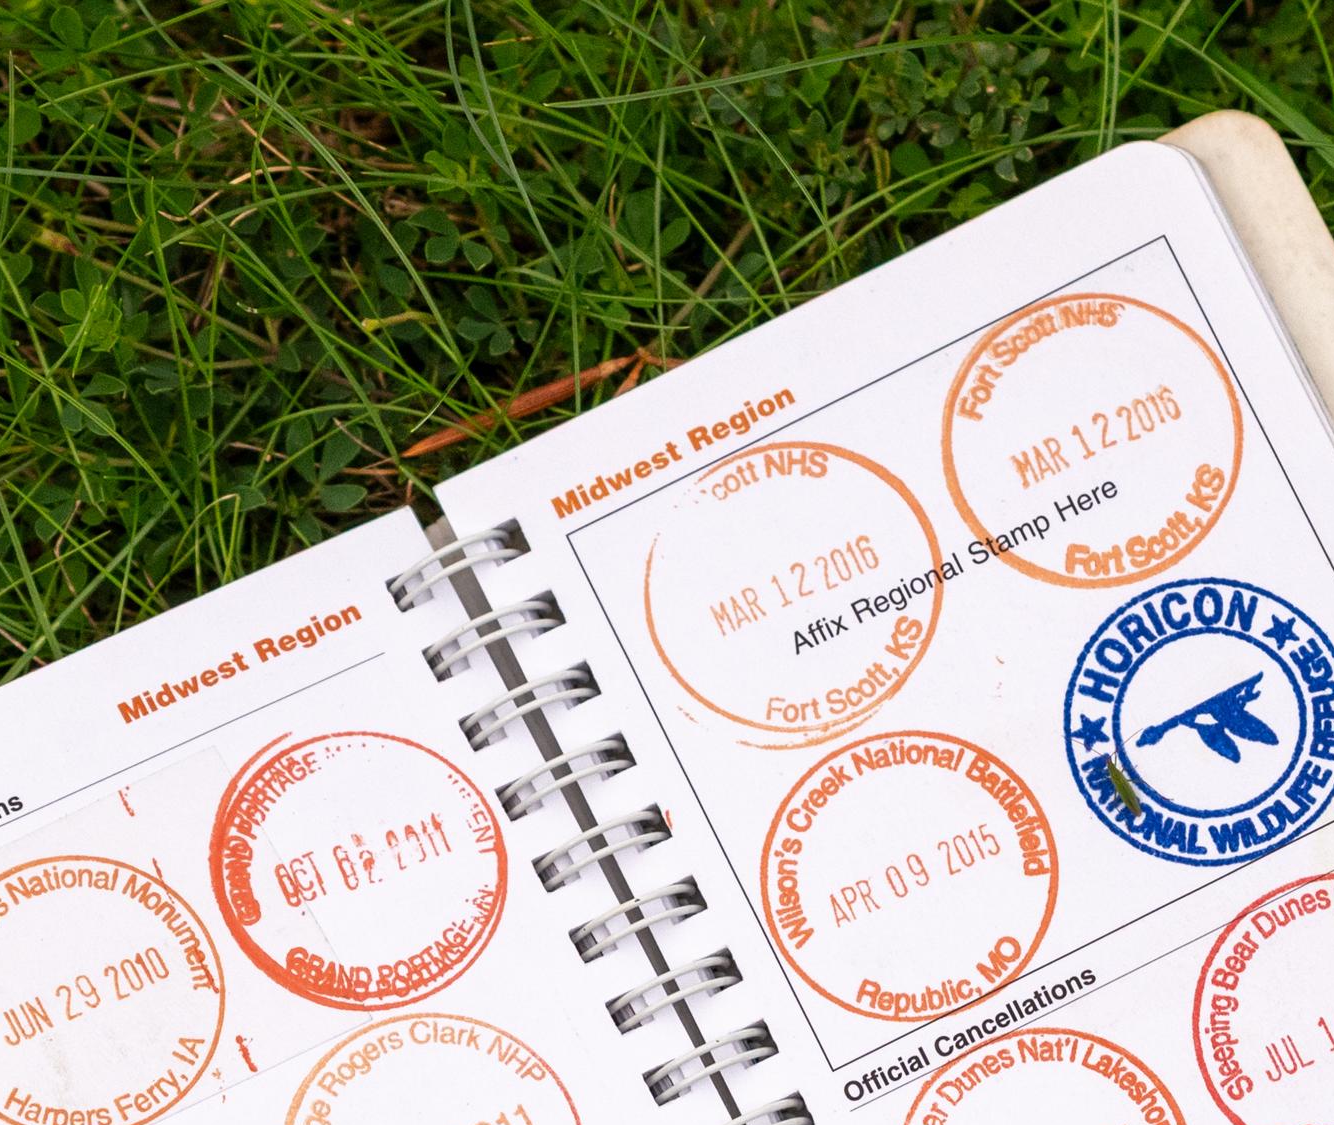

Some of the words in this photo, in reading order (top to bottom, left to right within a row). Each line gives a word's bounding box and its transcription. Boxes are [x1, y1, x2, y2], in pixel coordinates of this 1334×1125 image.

[957, 364, 1003, 421] Fort
[989, 311, 1059, 367] Scott
[551, 442, 682, 519] Midwest
[686, 388, 796, 451] Region
[764, 450, 828, 478] NHS
[1009, 437, 1070, 489] MAR
[792, 616, 848, 655] Affix
[851, 554, 963, 623] Regional
[967, 514, 1050, 565] Stamp
[1054, 481, 1118, 522] Here
[1066, 544, 1125, 576] Fort
[1126, 511, 1205, 568] Scott,
[1186, 464, 1224, 512] KS
[710, 587, 766, 637] MAR
[814, 535, 879, 590] 2016
[117, 652, 249, 724] Midwest
[253, 605, 362, 662] Region
[766, 697, 821, 722] Fort
[826, 662, 900, 714] Scott,
[885, 615, 923, 660] KS
[1078, 587, 1258, 703] HORICON
[786, 764, 853, 832] Creek
[851, 739, 965, 775] National
[1209, 761, 1332, 854] WILDLIFE
[965, 754, 1050, 876] Battlefield
[774, 837, 814, 949] Wilson's
[829, 880, 881, 928] APR
[938, 824, 1000, 875] 2015
[1251, 888, 1331, 939] Dunes
[5, 866, 119, 904] National
[122, 874, 211, 991] Monument
[856, 979, 982, 1019] Republic,
[976, 936, 1022, 983] MO
[1211, 931, 1259, 991] Bear
[4, 997, 53, 1046] JUN
[105, 948, 169, 1000] 2010
[844, 1046, 930, 1101] Official
[934, 969, 1096, 1056] Cancellations
[1205, 994, 1254, 1100] Sleeping
[114, 1069, 188, 1120] Ferry,
[172, 1037, 205, 1065] IA
[317, 1030, 404, 1097] Rogers
[409, 1021, 480, 1050] Clark
[487, 1035, 546, 1083] NHP
[936, 1047, 1015, 1106] Dunes
[1017, 1037, 1078, 1063] Nat'l
[1265, 1035, 1315, 1082] JUL
